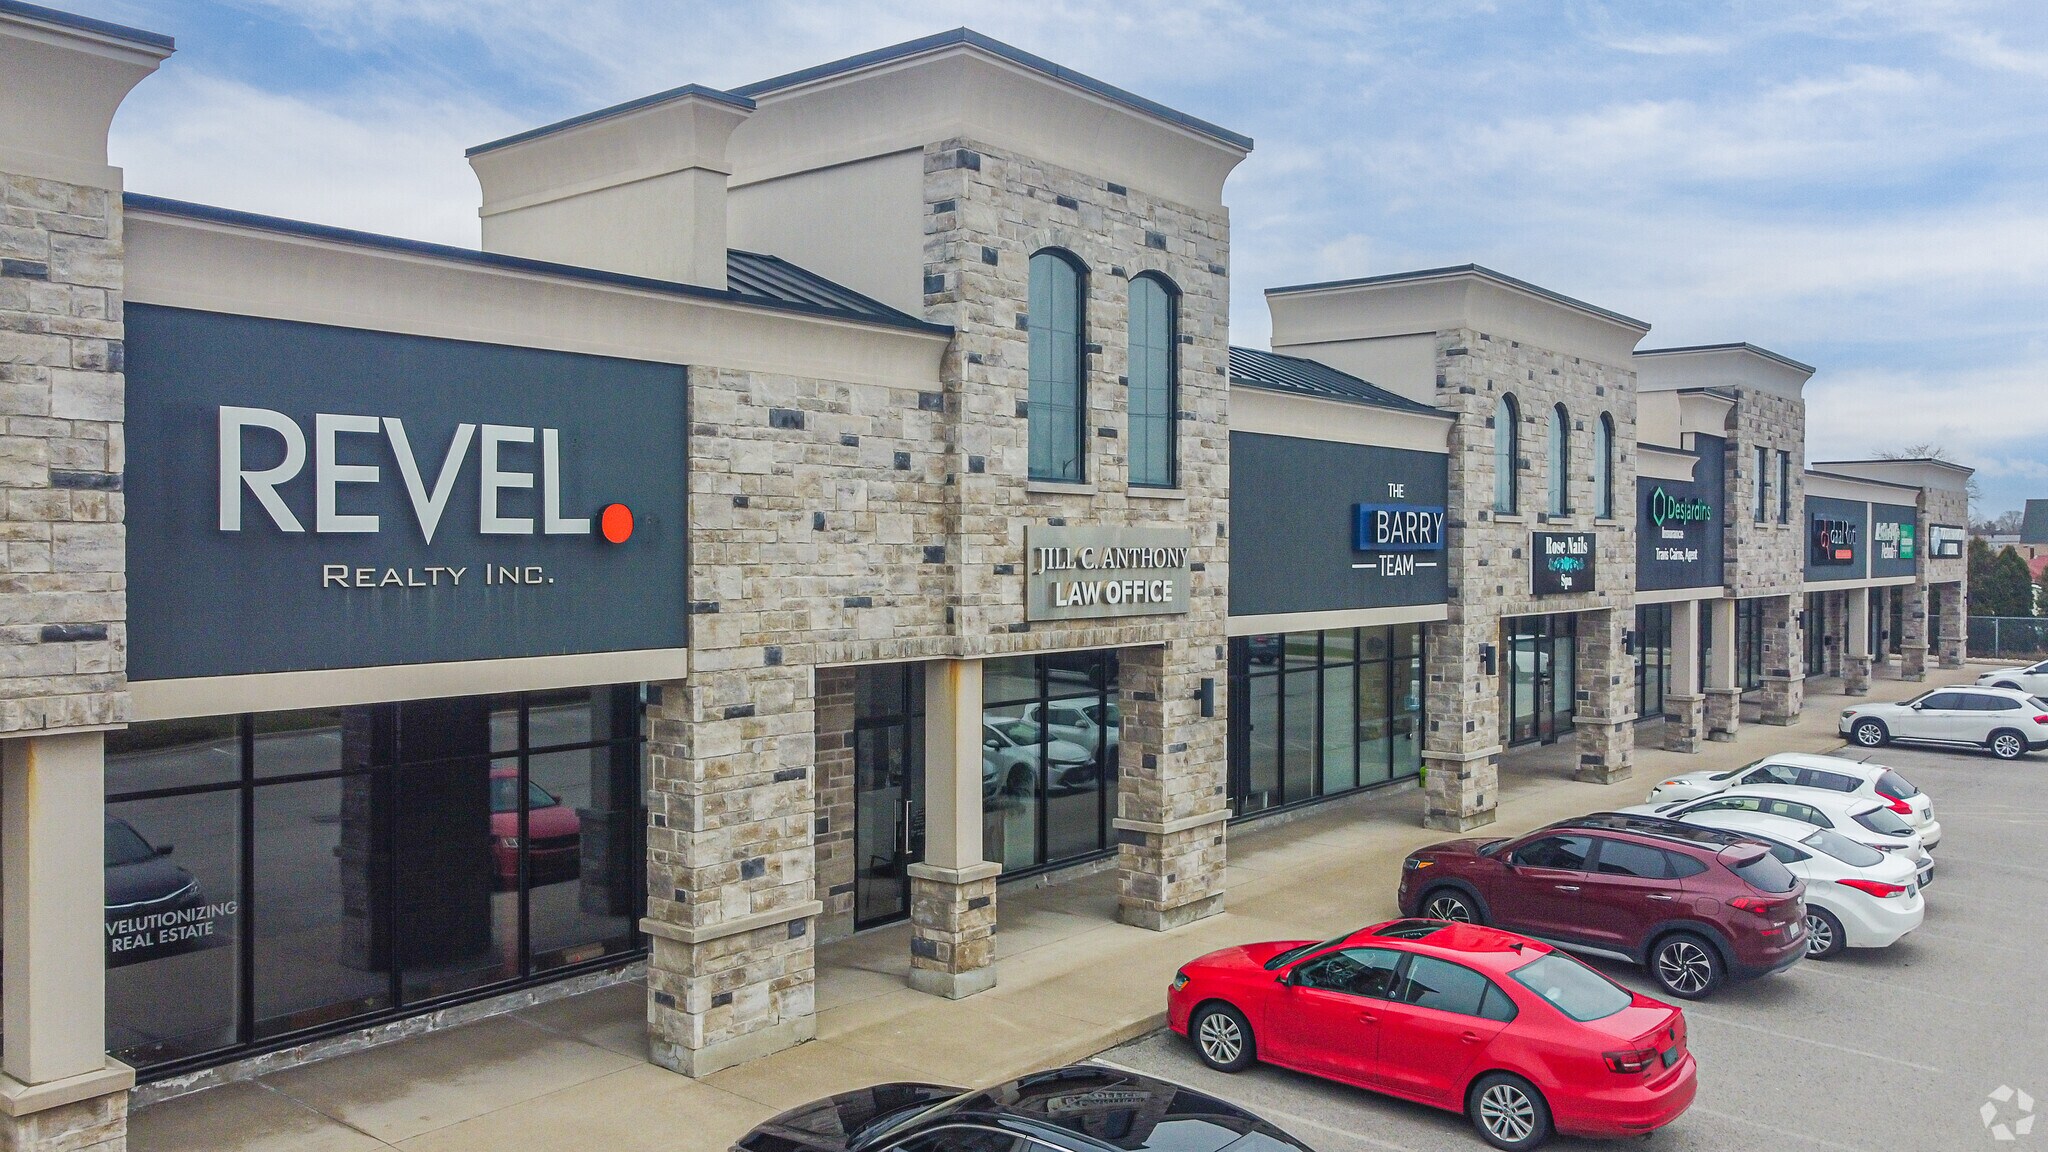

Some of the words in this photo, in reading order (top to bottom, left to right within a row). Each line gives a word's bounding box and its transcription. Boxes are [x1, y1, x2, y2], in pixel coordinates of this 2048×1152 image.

[1388, 483, 1405, 498] THE
[1668, 495, 1712, 525] Desjardins
[1377, 510, 1444, 543] BARRY
[1545, 536, 1566, 554] Rose
[1567, 536, 1588, 554] Nails
[1685, 547, 1698, 562] Agent
[1038, 547, 1076, 575] JILL
[1081, 547, 1099, 569] C.
[1102, 547, 1190, 569] ANTHONY
[1379, 554, 1414, 576] TEAM
[1560, 573, 1572, 589] Spa
[1055, 580, 1101, 607] LAW
[1105, 580, 1173, 604] OFFICE
[112, 933, 154, 952] REAL
[159, 921, 214, 944] ESTATE
